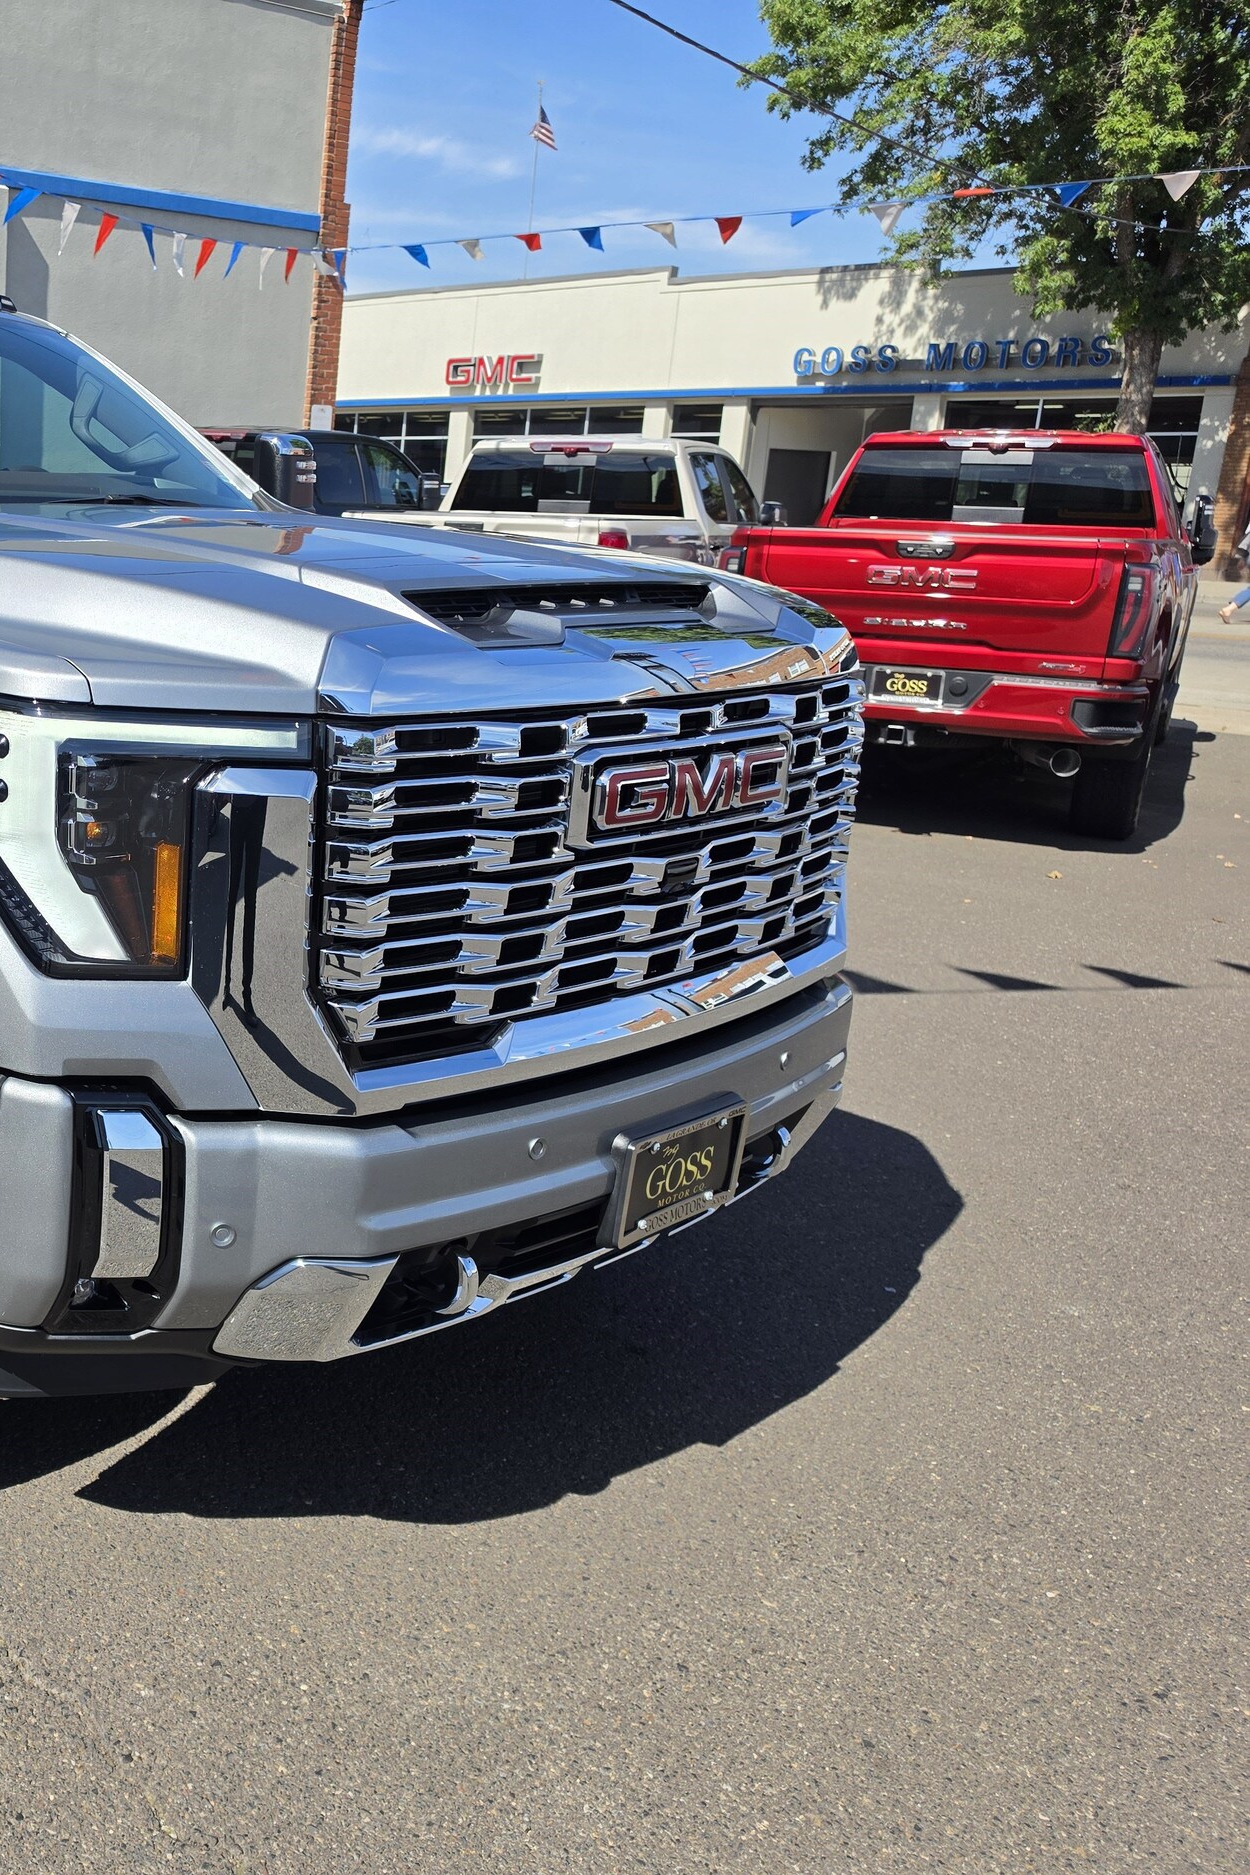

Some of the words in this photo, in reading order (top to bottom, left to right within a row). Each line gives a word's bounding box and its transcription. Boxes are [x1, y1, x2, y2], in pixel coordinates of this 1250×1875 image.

[445, 353, 540, 388] GMC
[792, 343, 900, 378] GOSS
[925, 334, 1115, 373] MOTORS
[866, 564, 979, 589] GMC
[886, 678, 928, 693] GOSS
[594, 743, 786, 829] GMC
[645, 1145, 715, 1200] GOSS
[657, 1188, 690, 1209] MOTOR
